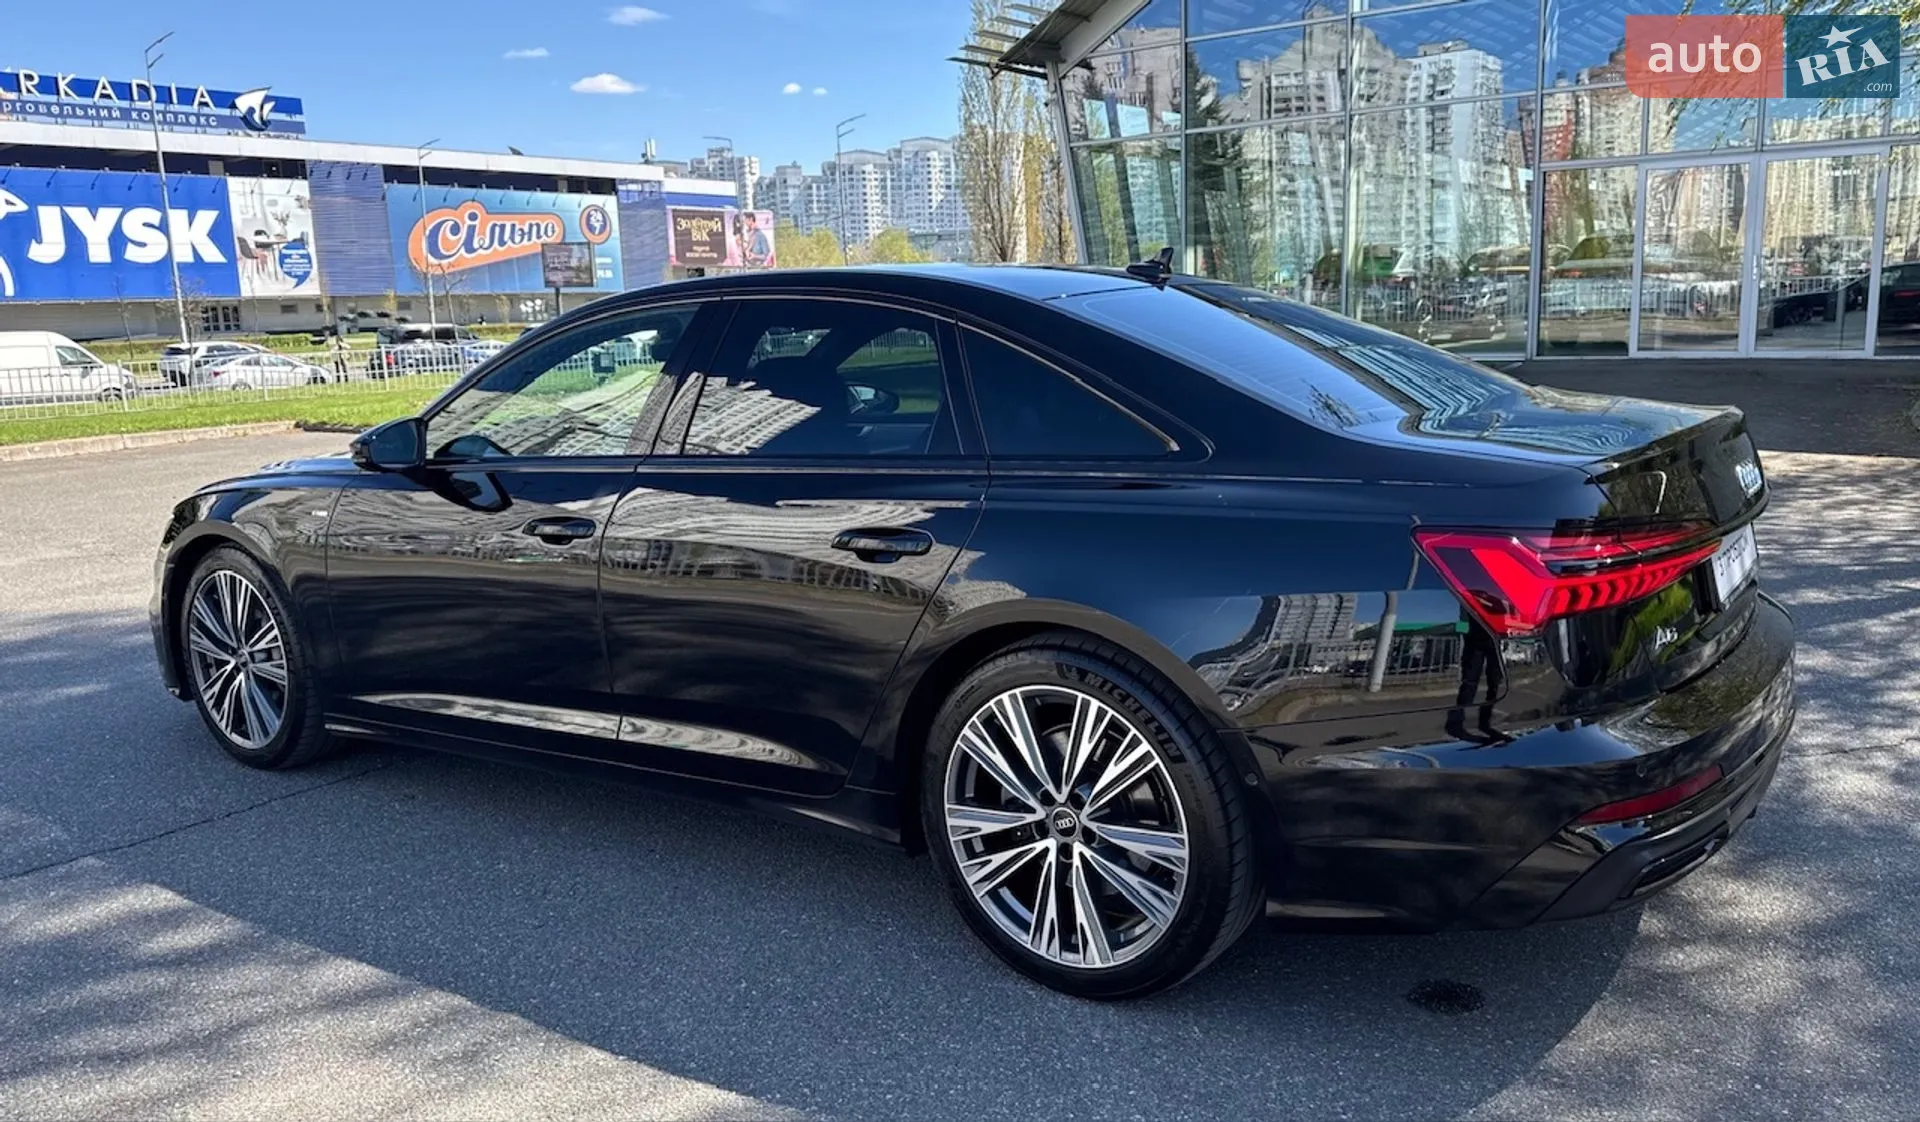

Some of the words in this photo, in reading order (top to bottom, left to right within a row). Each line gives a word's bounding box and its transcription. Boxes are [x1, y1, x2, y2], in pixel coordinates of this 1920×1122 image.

[0, 68, 216, 111] RKADIA
[132, 110, 218, 126] комплекс
[27, 205, 228, 264] JYSK
[424, 210, 558, 262] Сільпо
[1083, 671, 1183, 763] MICHELIN
